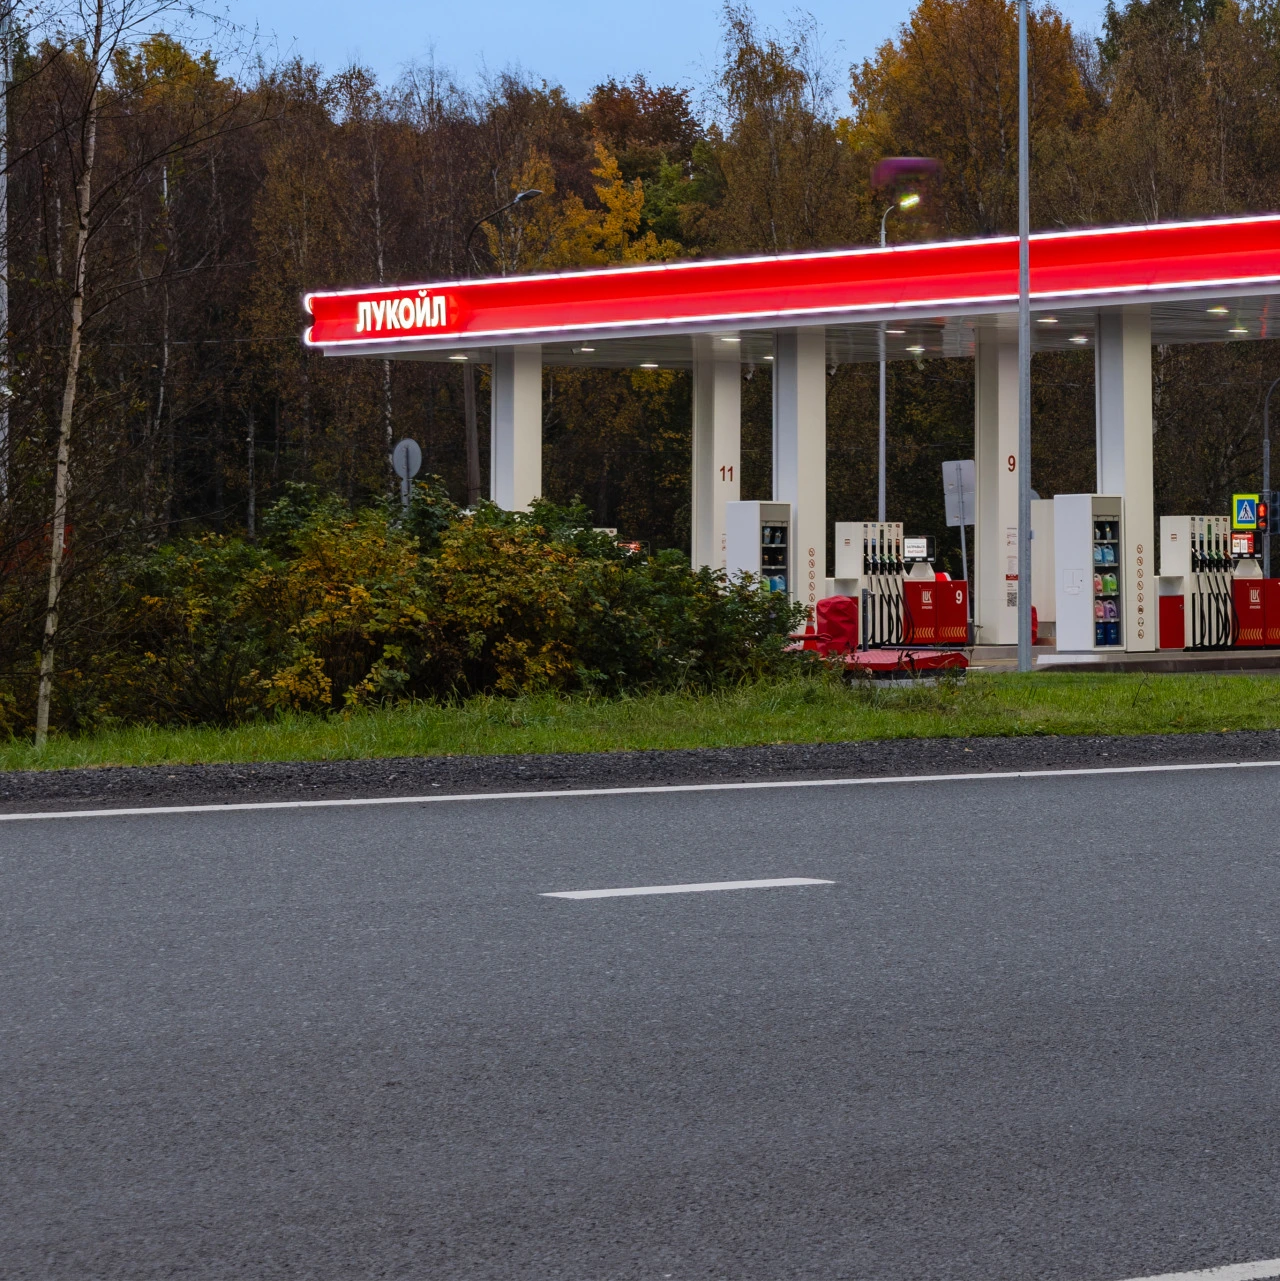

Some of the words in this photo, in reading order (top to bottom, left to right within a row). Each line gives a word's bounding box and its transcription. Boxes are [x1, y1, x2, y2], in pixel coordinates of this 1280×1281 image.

[356, 289, 447, 333] ЛУКОЙЛ
[1007, 455, 1016, 472] 9
[719, 465, 733, 482] 11
[955, 590, 963, 604] 9
